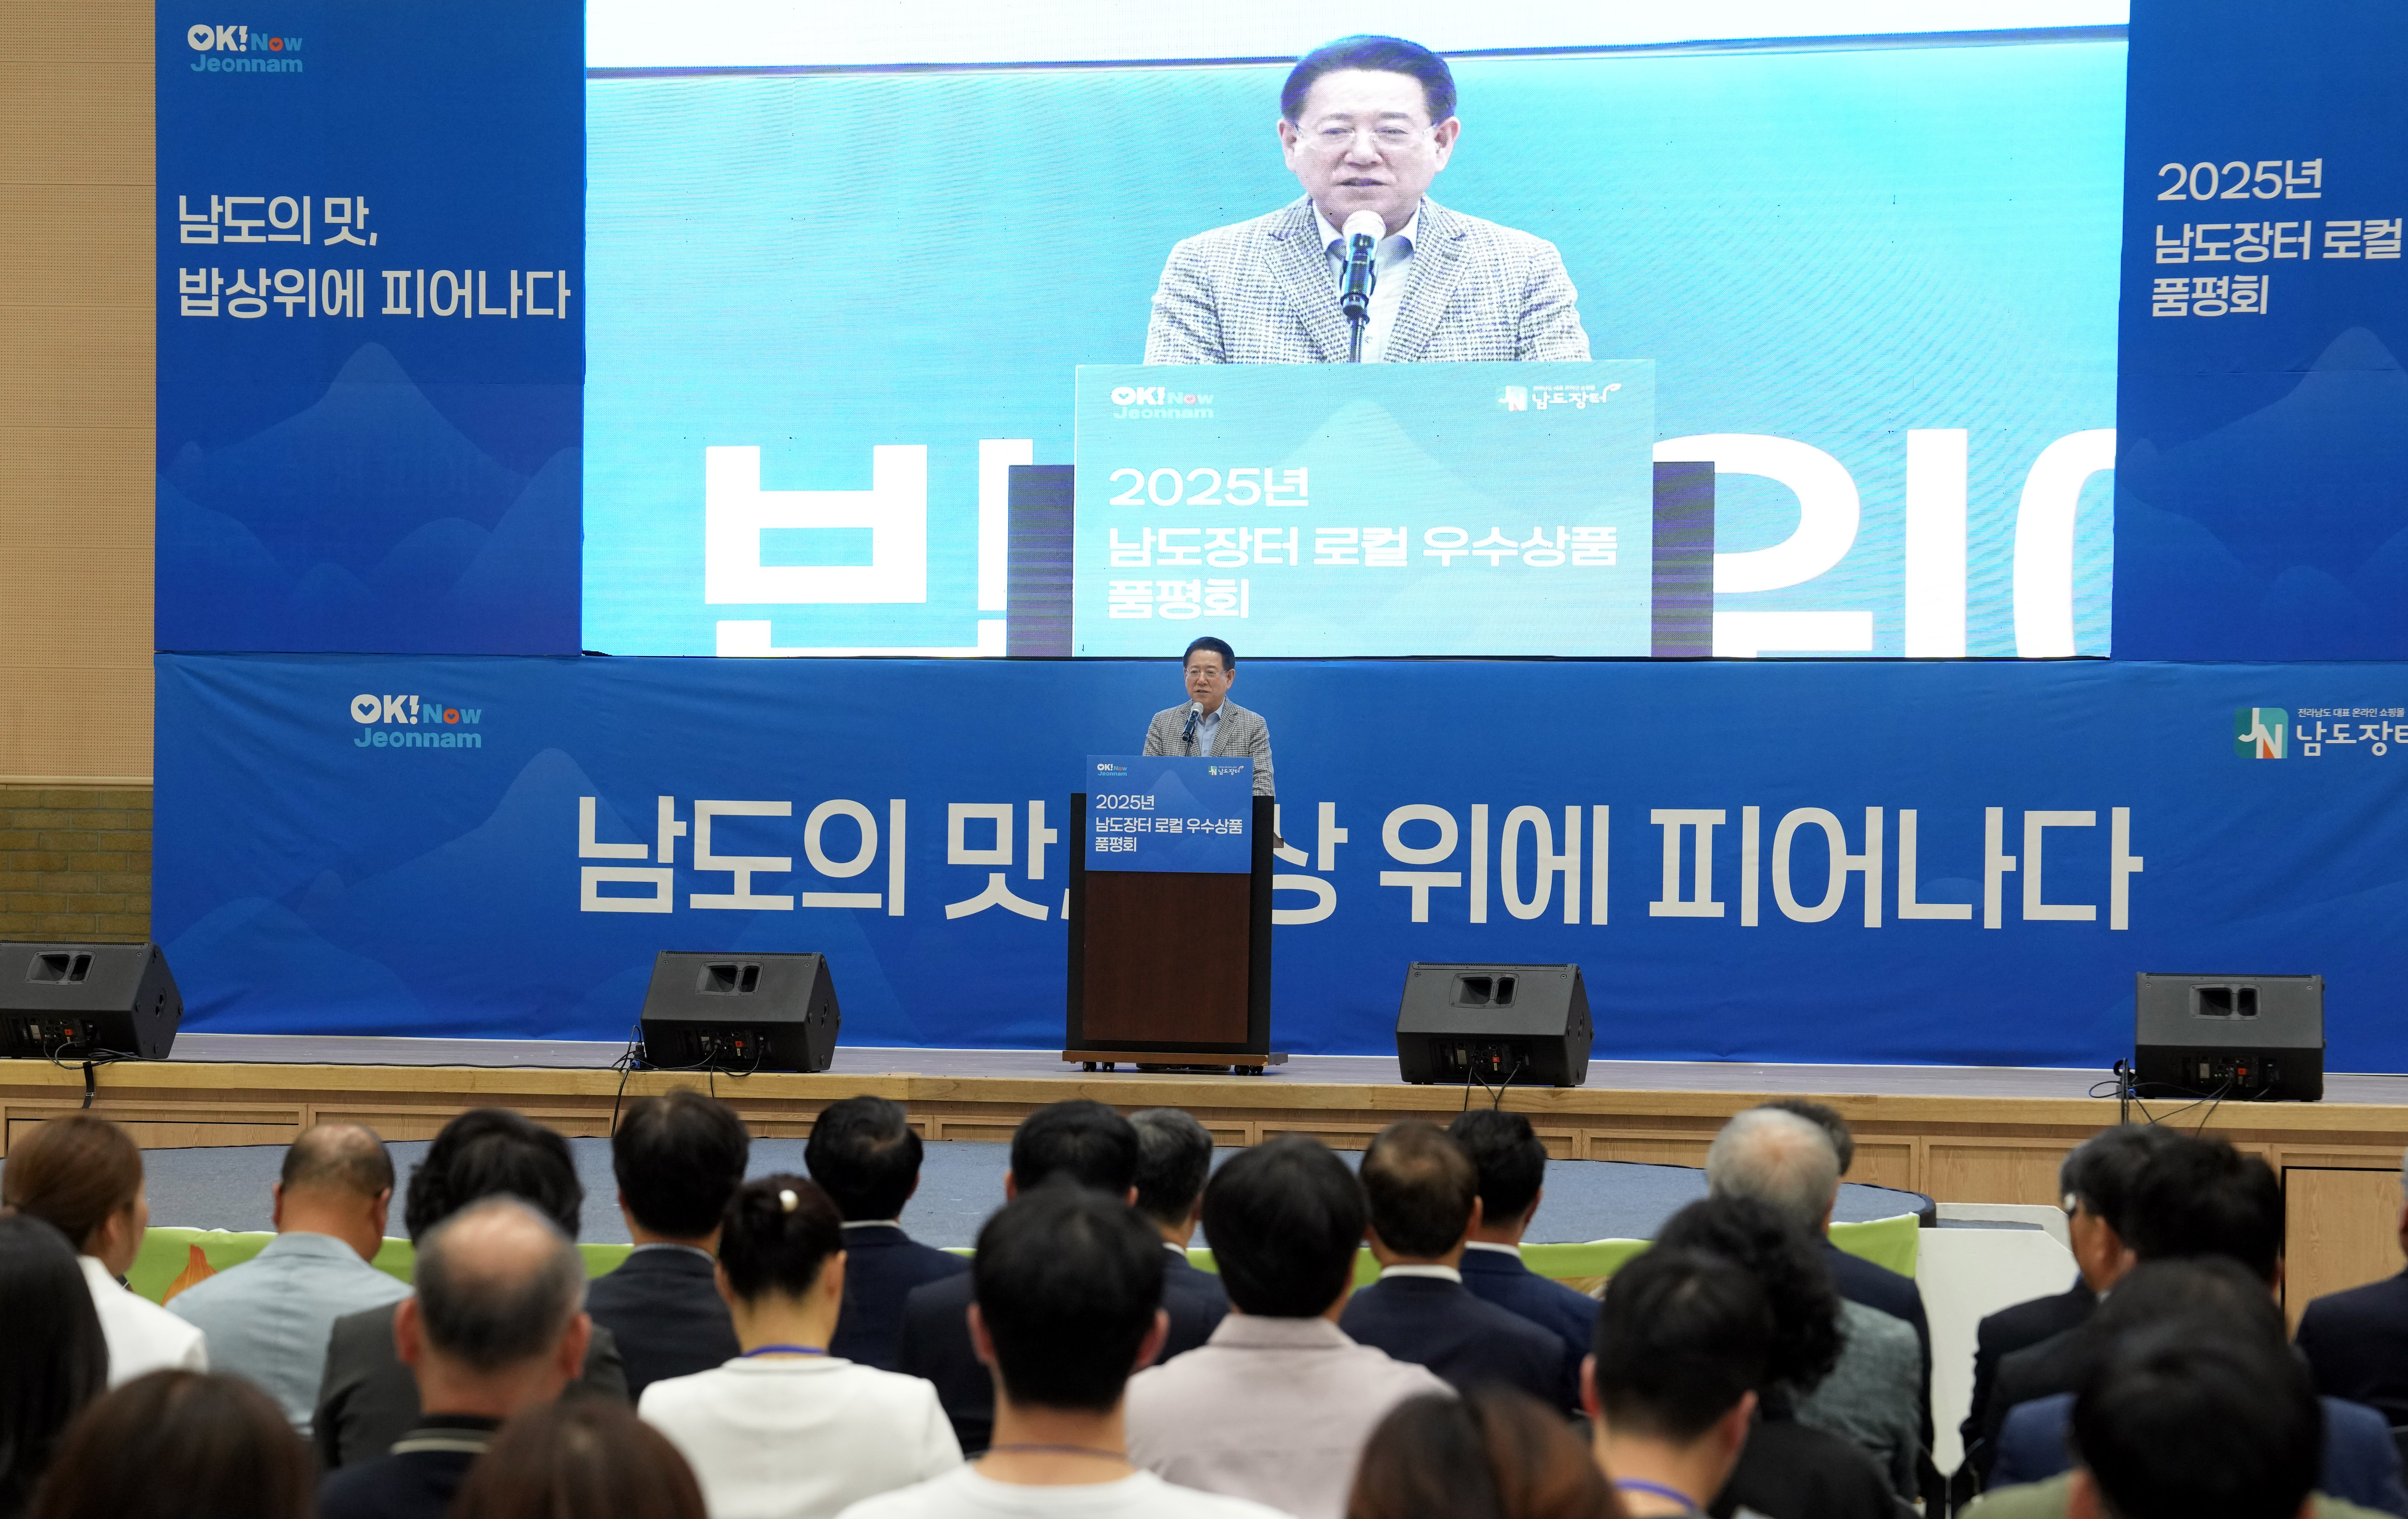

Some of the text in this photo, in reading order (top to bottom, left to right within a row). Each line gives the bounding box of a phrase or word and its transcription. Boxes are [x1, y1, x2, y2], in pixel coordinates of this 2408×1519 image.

[187, 24, 303, 52] OK! Now
[190, 54, 303, 72] Jeonnam
[2157, 158, 2322, 201] 2025년
[179, 195, 378, 246] 남도의 맛,
[2155, 218, 2402, 264] 남도장터 로컬
[179, 268, 571, 319] 밥상위에 피어나다
[2152, 275, 2269, 317] 품평회
[1111, 387, 1214, 405] OK! Now
[1532, 384, 1622, 409] 남도장터
[1113, 407, 1214, 419] Jeonnam
[1109, 467, 1309, 507] 2025년
[1109, 525, 1618, 567] 남도장터 로컬 우수상품
[1108, 579, 1249, 620] 품평회
[351, 694, 482, 725] OK! Now
[2298, 708, 2405, 718] 전라남도 대표 온라인 쇼핑몰
[354, 727, 482, 748] Jeonnam
[1218, 766, 1244, 775] 남도장터
[1096, 794, 1155, 810] 2025년
[1096, 817, 1243, 835] 남도장터 로컬 우수상품
[1095, 836, 1137, 852] 품평회
[578, 795, 906, 916] 남도의
[1380, 804, 1609, 925] 위에
[1649, 806, 2144, 930] 피어나다
